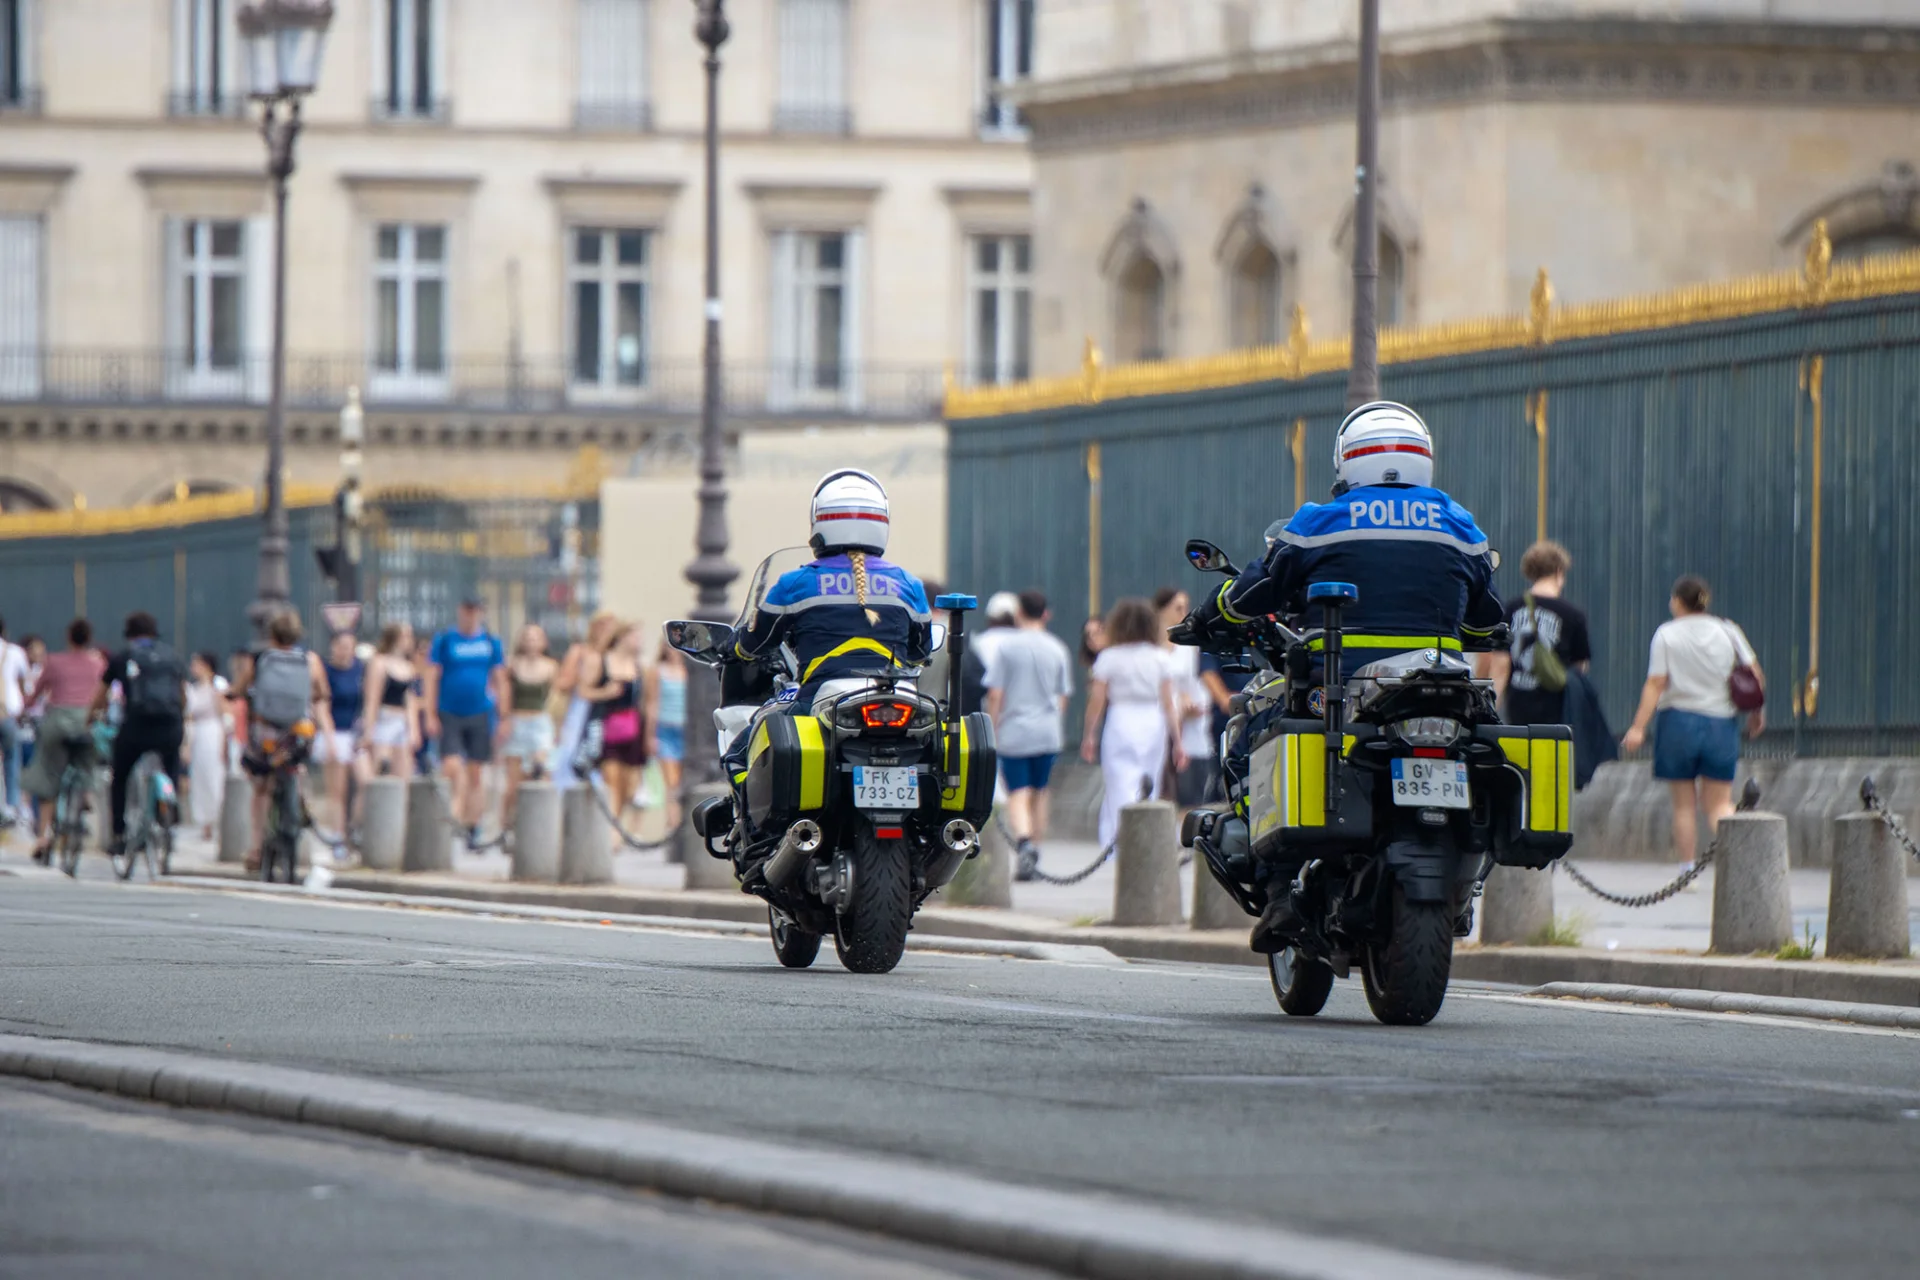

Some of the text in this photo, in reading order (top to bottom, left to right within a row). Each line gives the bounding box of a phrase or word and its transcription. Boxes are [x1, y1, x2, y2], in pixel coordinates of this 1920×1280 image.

[1349, 499, 1442, 529] POLICE
[871, 771, 890, 785] FK
[1412, 763, 1434, 779] GV
[858, 786, 916, 800] 733-CZ
[1397, 781, 1464, 798] 835-PN
